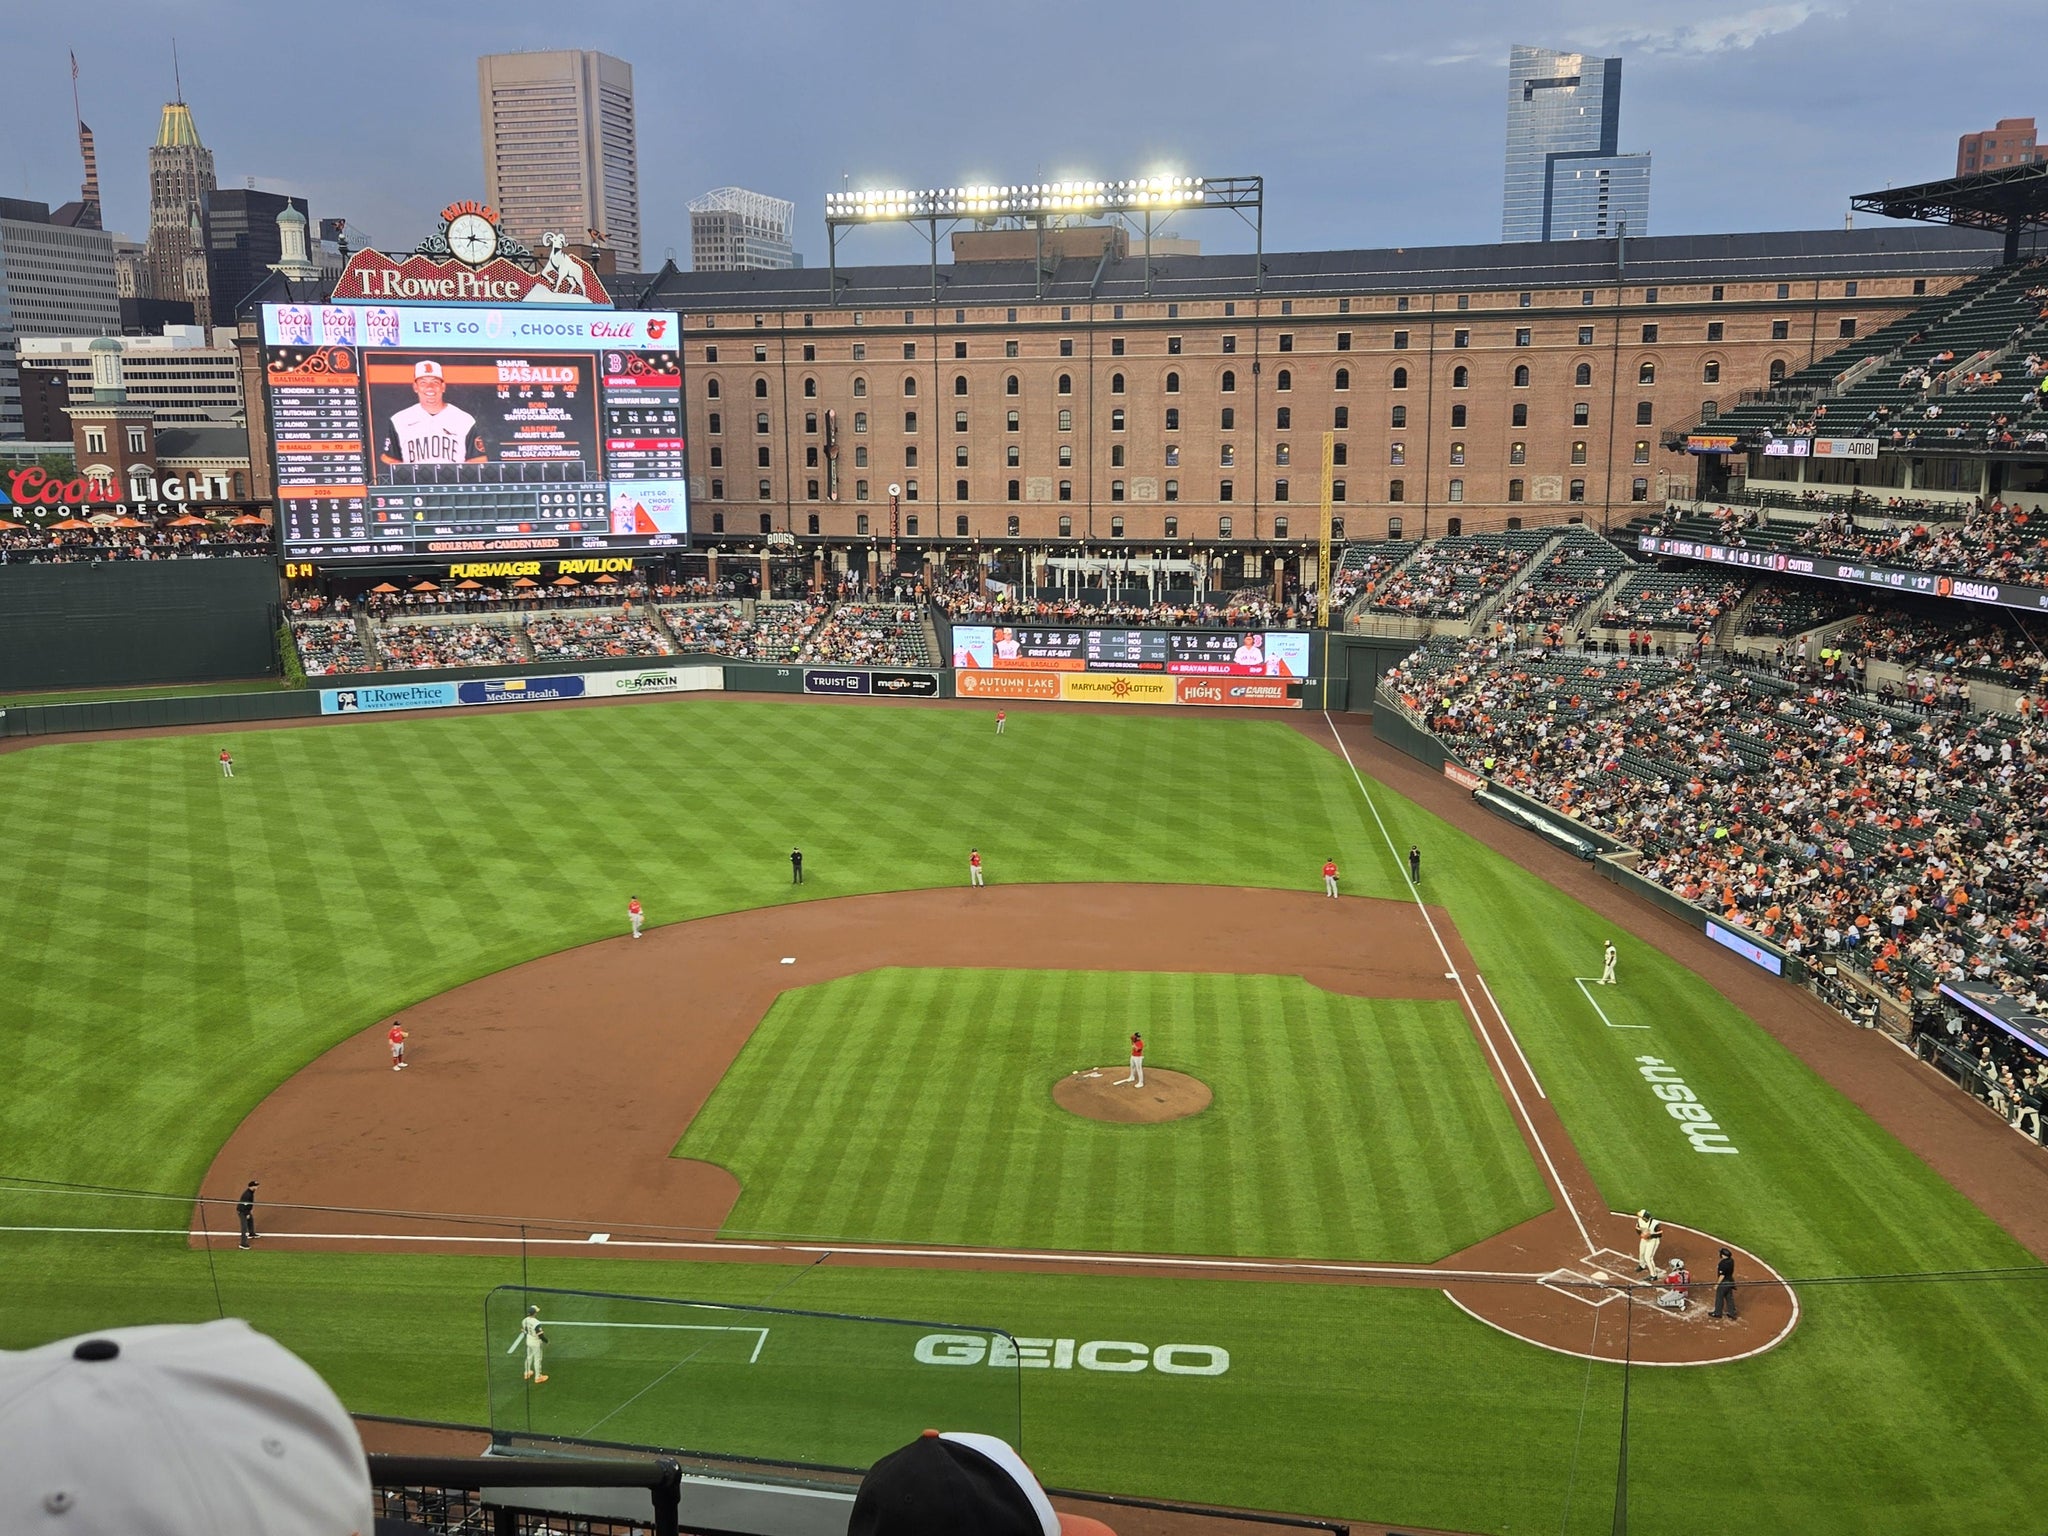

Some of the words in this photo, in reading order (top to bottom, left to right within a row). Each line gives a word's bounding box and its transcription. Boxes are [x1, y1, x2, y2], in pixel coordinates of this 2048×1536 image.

[413, 321, 452, 334] LET'S
[457, 322, 480, 334] GO
[520, 324, 584, 336] CHOOSE
[589, 321, 635, 339] Chill
[497, 367, 574, 382] BASALLO
[407, 435, 458, 463] BMORE
[1847, 442, 1875, 455] AMBI
[8, 466, 123, 505] Coors
[130, 477, 232, 502] LIGHT
[413, 497, 424, 507] 0
[541, 494, 550, 504] 0
[554, 494, 563, 504] 0
[566, 493, 576, 503] 0
[583, 493, 592, 503] 4
[596, 493, 604, 503] 2
[12, 504, 91, 518] ROOF
[116, 502, 189, 516] DECK
[415, 511, 424, 521] 4
[542, 508, 551, 518] 4
[555, 508, 564, 518] 4
[567, 507, 577, 517] 0
[584, 507, 592, 517] 4
[596, 507, 605, 517] 2
[350, 545, 371, 553] WEST
[428, 542, 462, 551] ORIOLE
[462, 541, 485, 550] PARK
[495, 539, 532, 549] CAMDEN
[531, 539, 560, 548] YARDS
[1679, 543, 1693, 556] BOS
[1695, 546, 1701, 557] 0
[1711, 548, 1725, 560] BAL
[1728, 550, 1735, 561] 4
[1787, 560, 1814, 572] CUTTER
[285, 562, 313, 578] 0:14
[450, 561, 542, 578] PUREWAGER
[558, 557, 634, 574] PAVILION
[1953, 581, 1999, 601] BASALLO
[1028, 649, 1046, 657] FIRST
[1003, 660, 1029, 668] SAMUEL
[1208, 665, 1231, 673] BELLO
[616, 679, 634, 689] CP
[634, 676, 678, 687] RANKIN
[813, 677, 846, 687] TRUIST
[979, 678, 1024, 687] AUTUMN
[1028, 679, 1054, 688] LAKE
[1072, 683, 1112, 691] MARYLAND
[1130, 685, 1163, 693] LOTTERY
[486, 691, 526, 702] MedStar
[526, 689, 560, 700] Health
[979, 686, 1055, 694] HEALTHCARE
[1185, 687, 1222, 700] HIGH'S
[1229, 687, 1246, 696] CF
[1246, 686, 1282, 695] CARROLL
[913, 1333, 1230, 1376] GEICO
